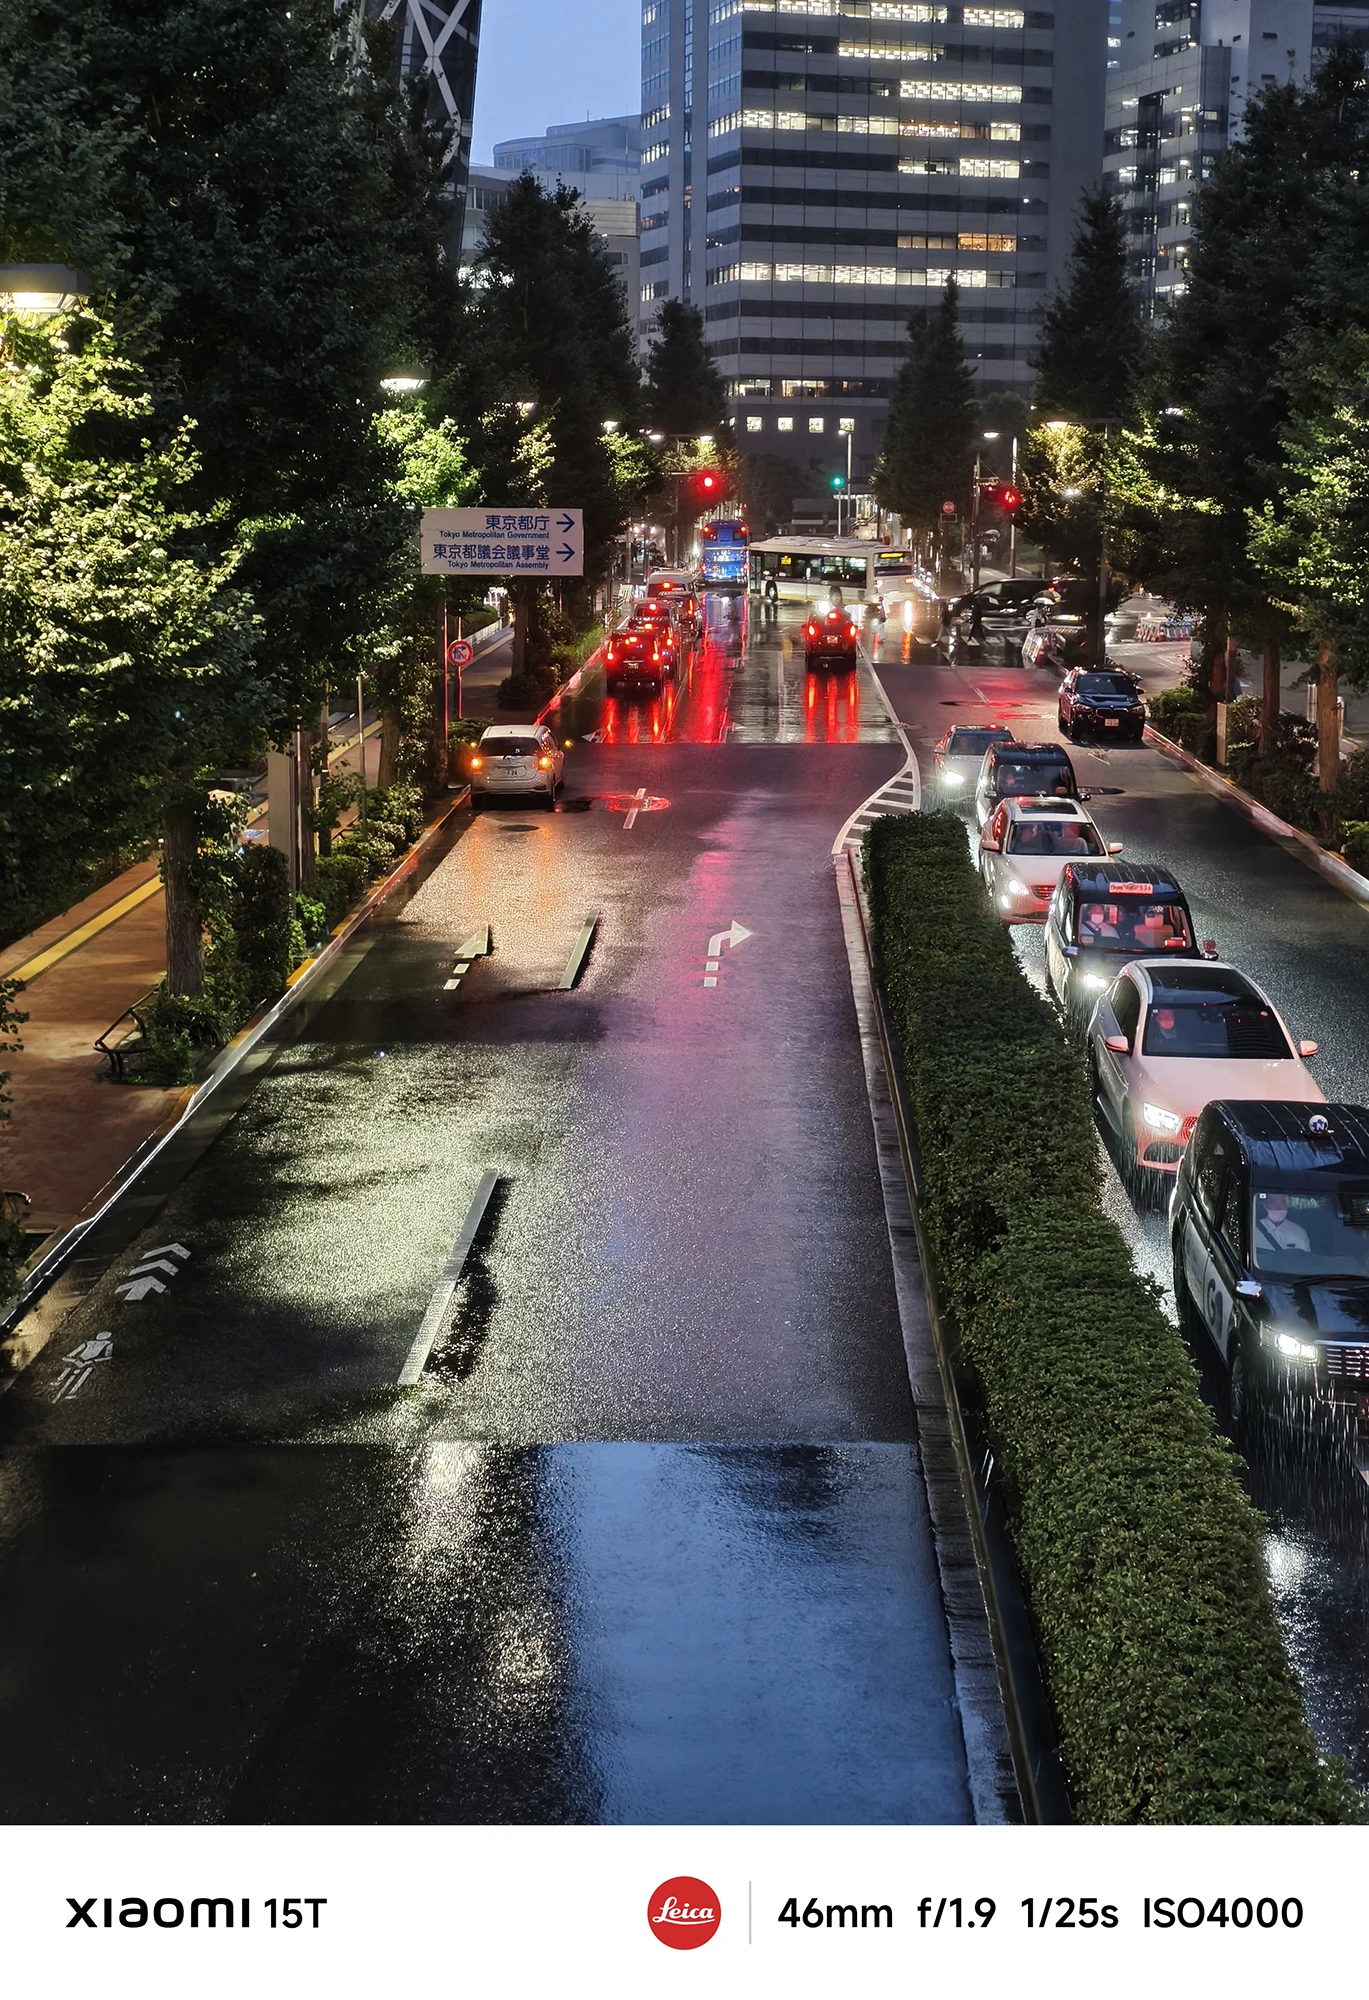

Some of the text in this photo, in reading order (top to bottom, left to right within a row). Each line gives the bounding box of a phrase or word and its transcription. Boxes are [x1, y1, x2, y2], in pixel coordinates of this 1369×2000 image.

[485, 514, 550, 531] 東京都庁
[440, 531, 550, 539] Tokyo Metropolitan Government
[433, 543, 550, 560] 東京都議会議事堂
[448, 561, 549, 570] Tokyo Metropolitan Assembly
